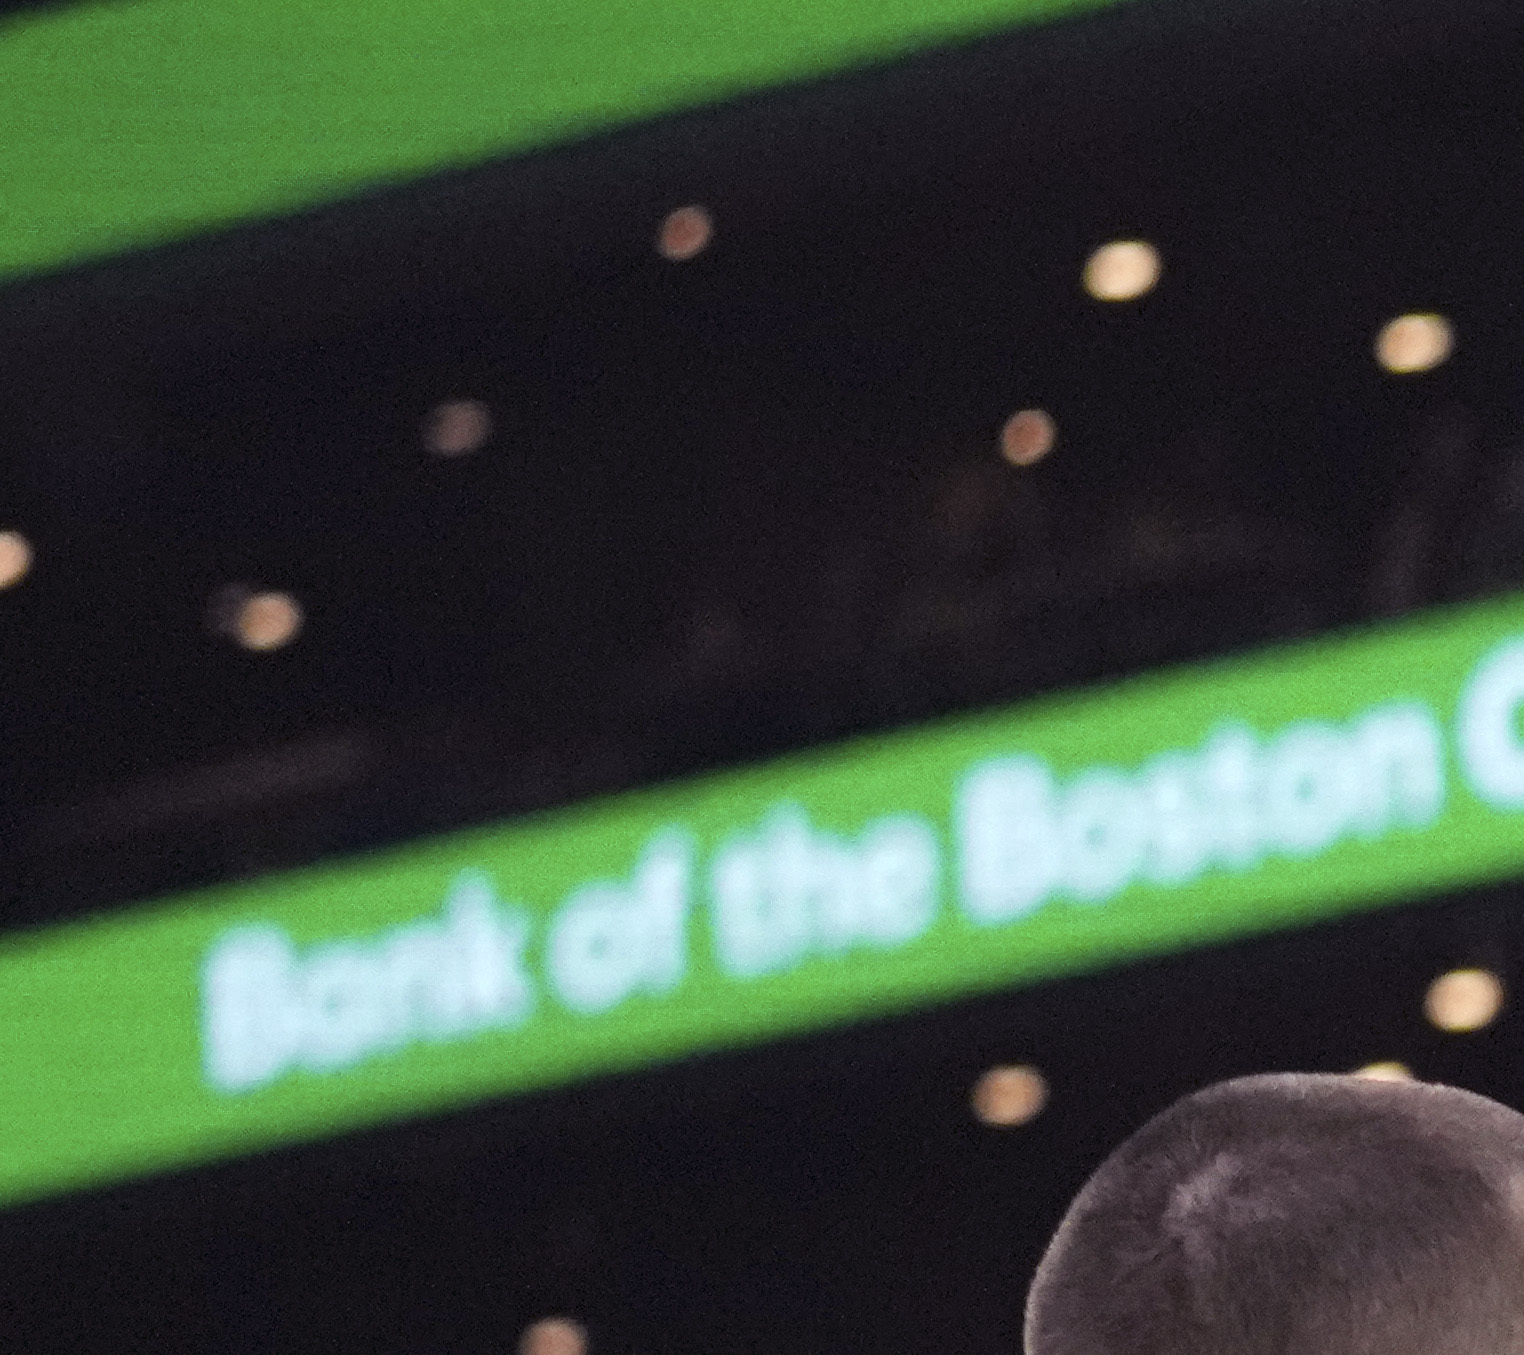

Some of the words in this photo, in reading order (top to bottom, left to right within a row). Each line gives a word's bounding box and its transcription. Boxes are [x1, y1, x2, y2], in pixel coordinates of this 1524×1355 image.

[203, 868, 535, 1094] Bank
[548, 823, 696, 1016] of
[711, 802, 940, 978] the
[955, 702, 1446, 927] Boston
